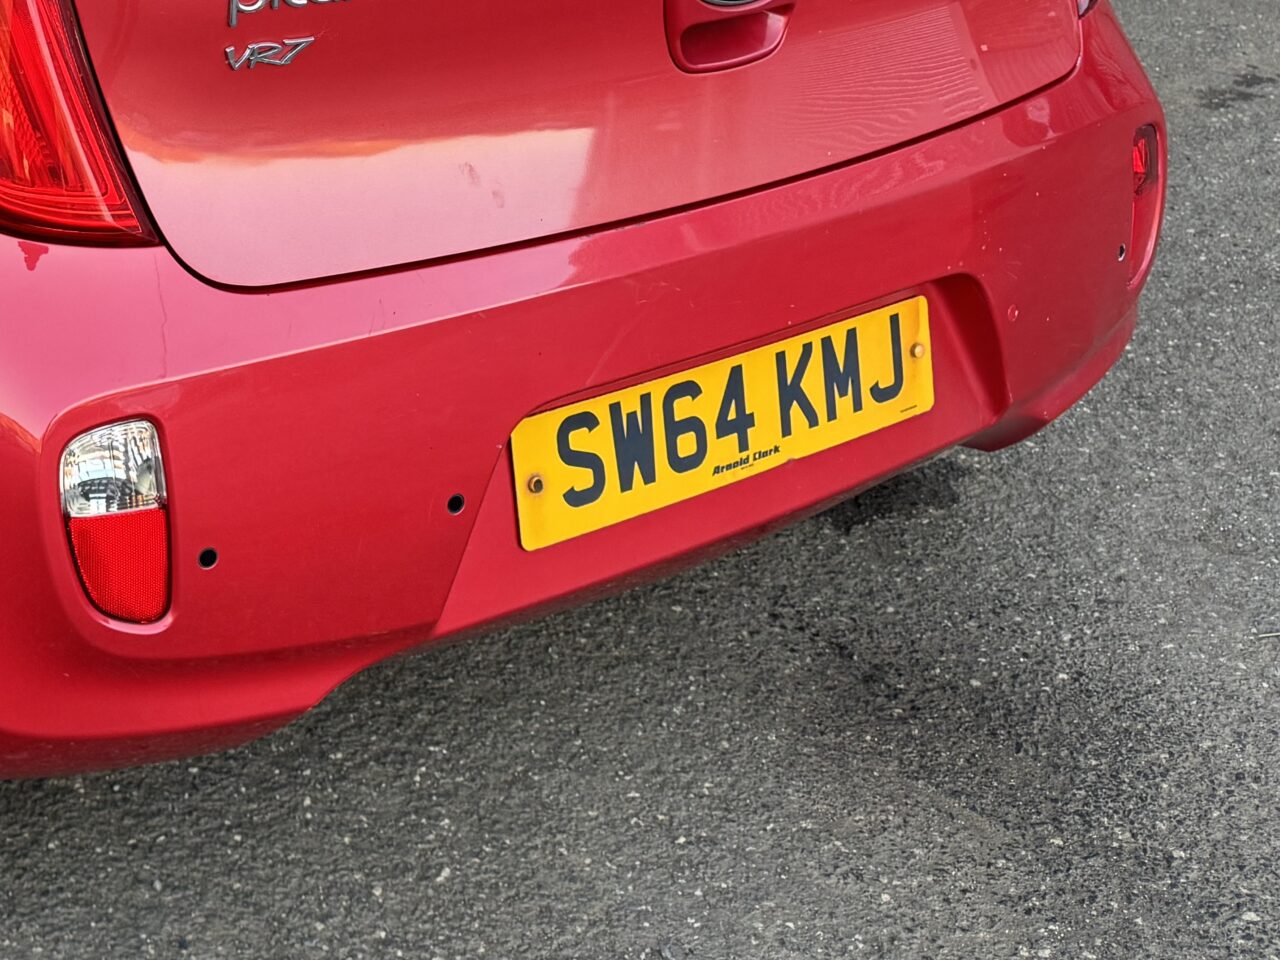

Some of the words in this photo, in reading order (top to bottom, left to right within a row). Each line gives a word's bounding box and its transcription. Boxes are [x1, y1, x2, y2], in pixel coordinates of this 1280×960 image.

[225, 36, 315, 71] VR7
[556, 363, 756, 508] SW64
[774, 313, 904, 439] KMJ
[712, 455, 750, 477] Arnold
[753, 445, 781, 462] Clark
